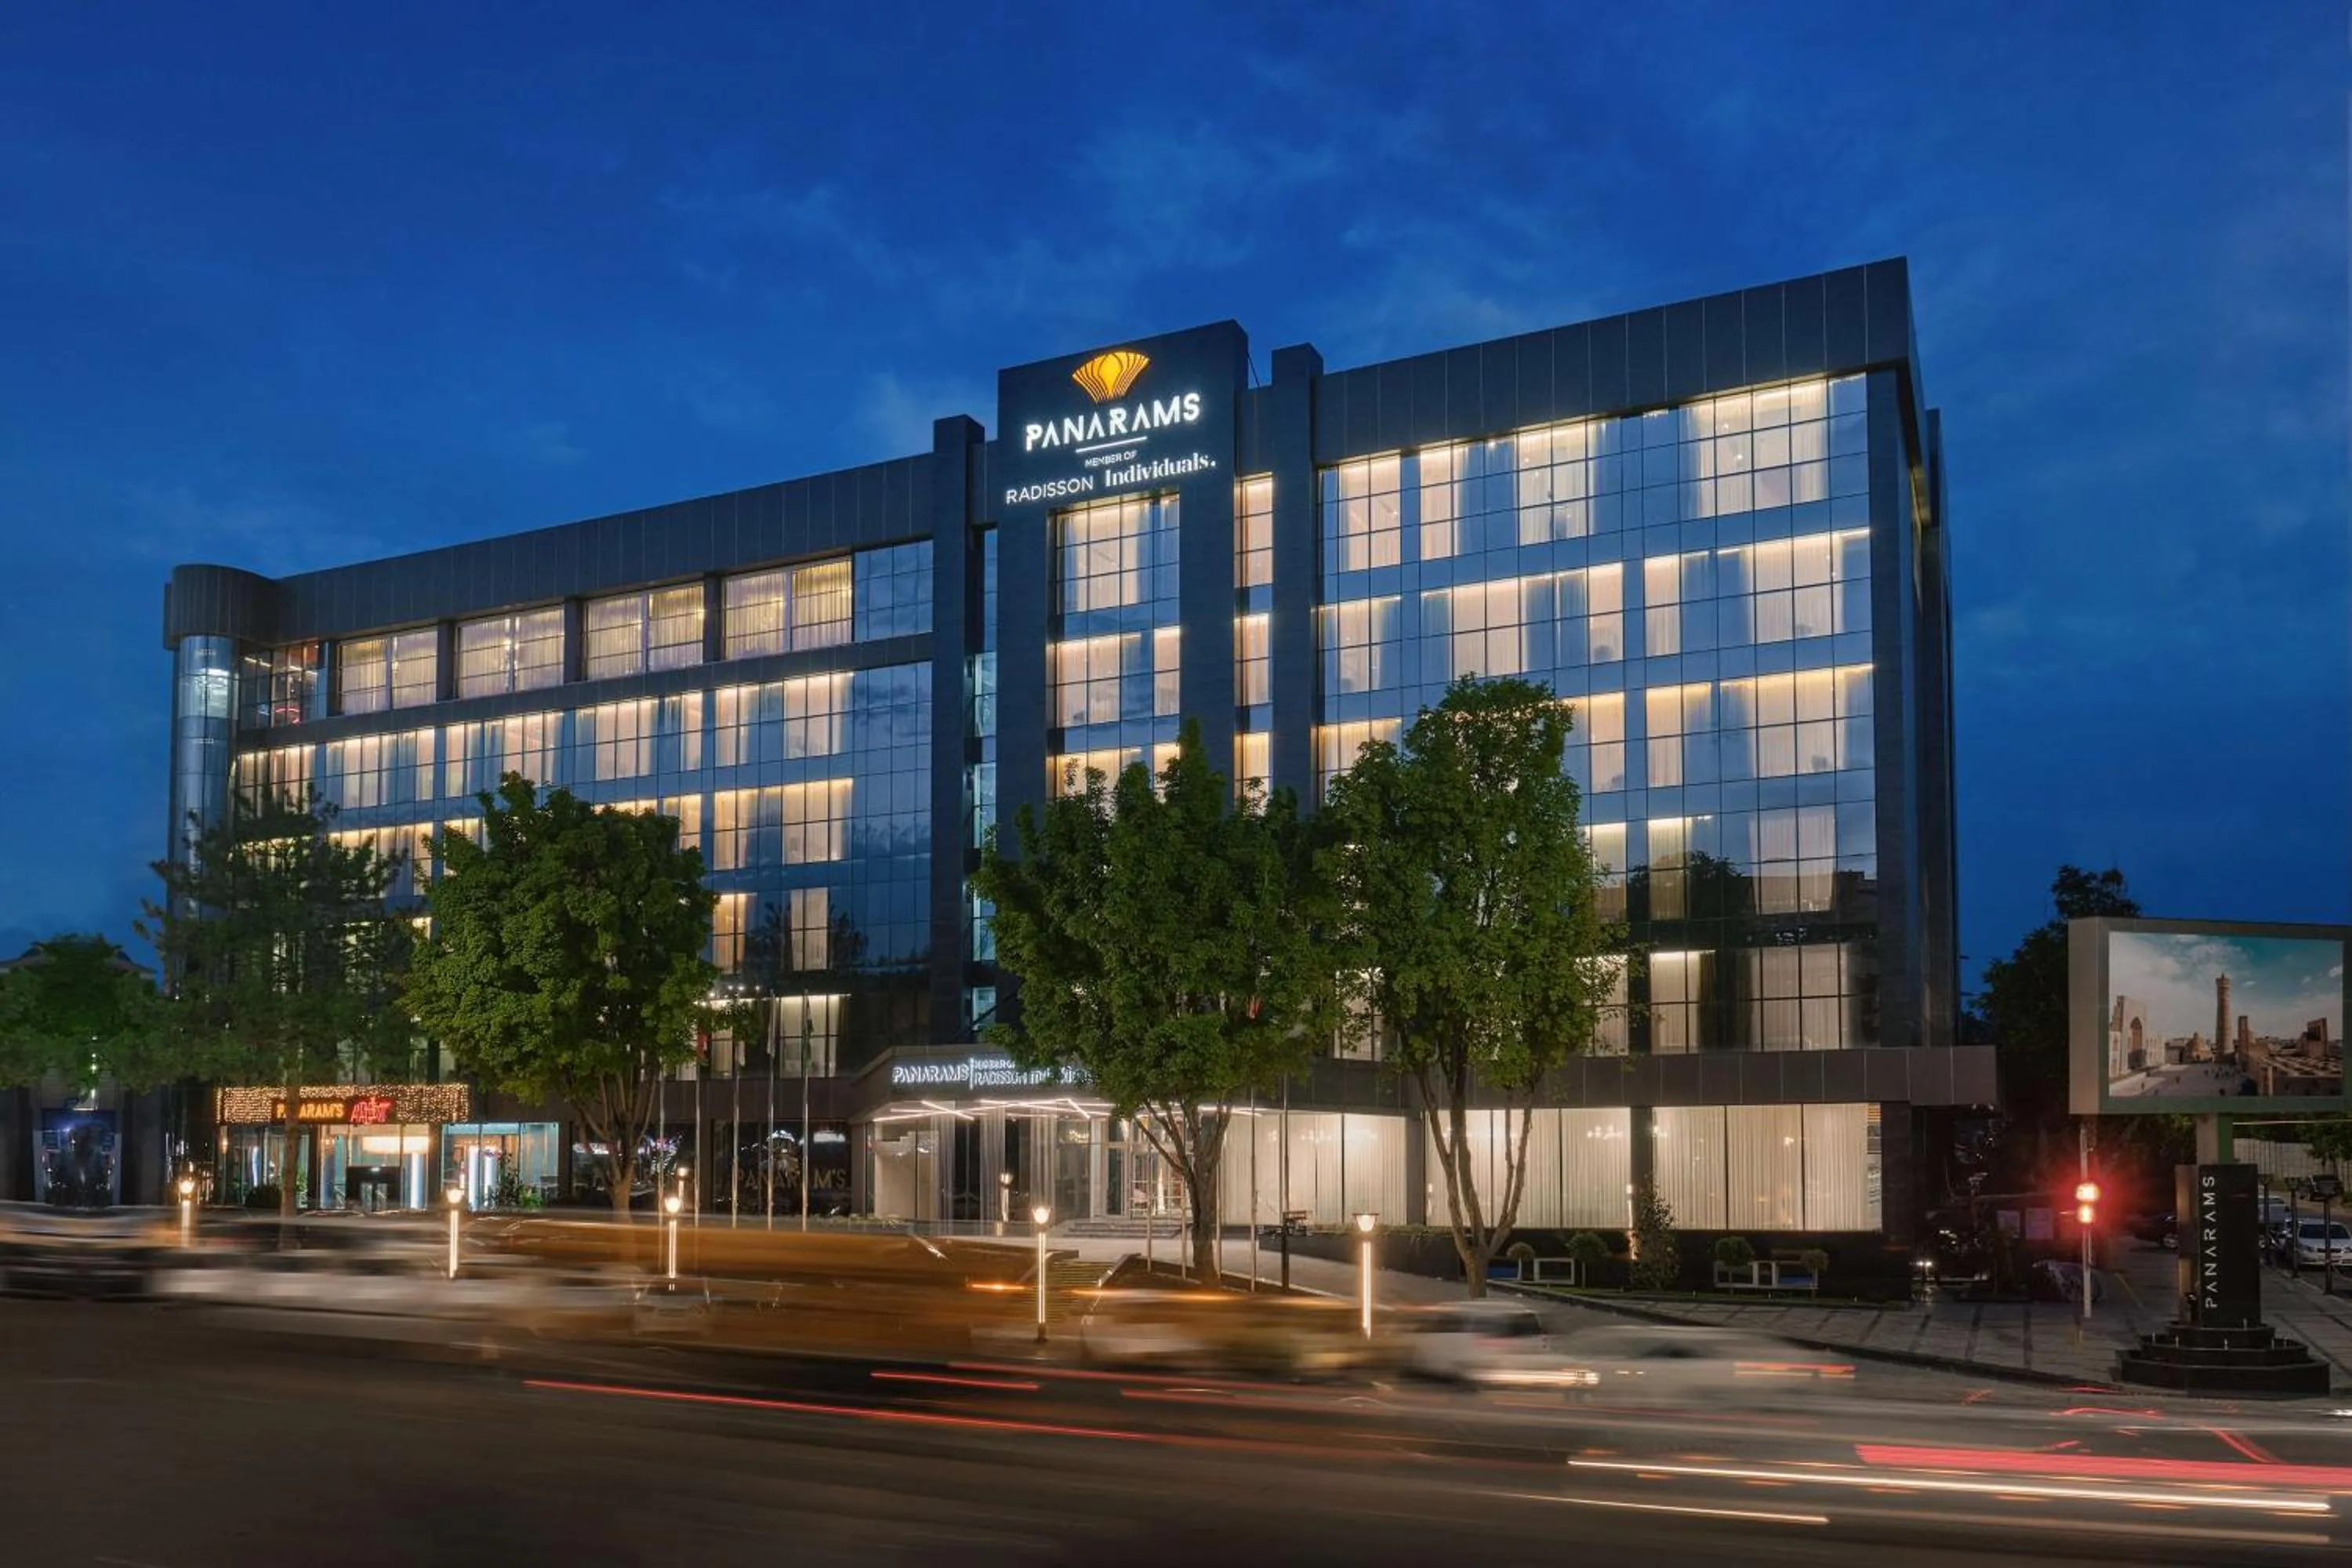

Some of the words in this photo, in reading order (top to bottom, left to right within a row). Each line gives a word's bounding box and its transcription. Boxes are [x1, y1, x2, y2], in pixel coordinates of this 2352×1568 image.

[1025, 393, 1201, 452] PANARAMS
[1084, 453, 1123, 468] MEMBER
[1123, 449, 1138, 462] OF
[1006, 475, 1094, 504] RADISSON
[1105, 452, 1217, 488] Individuals.
[892, 1063, 970, 1083] PANARAMS
[276, 1102, 345, 1120] PARAM'S
[2202, 1175, 2219, 1309] PANARAMS
